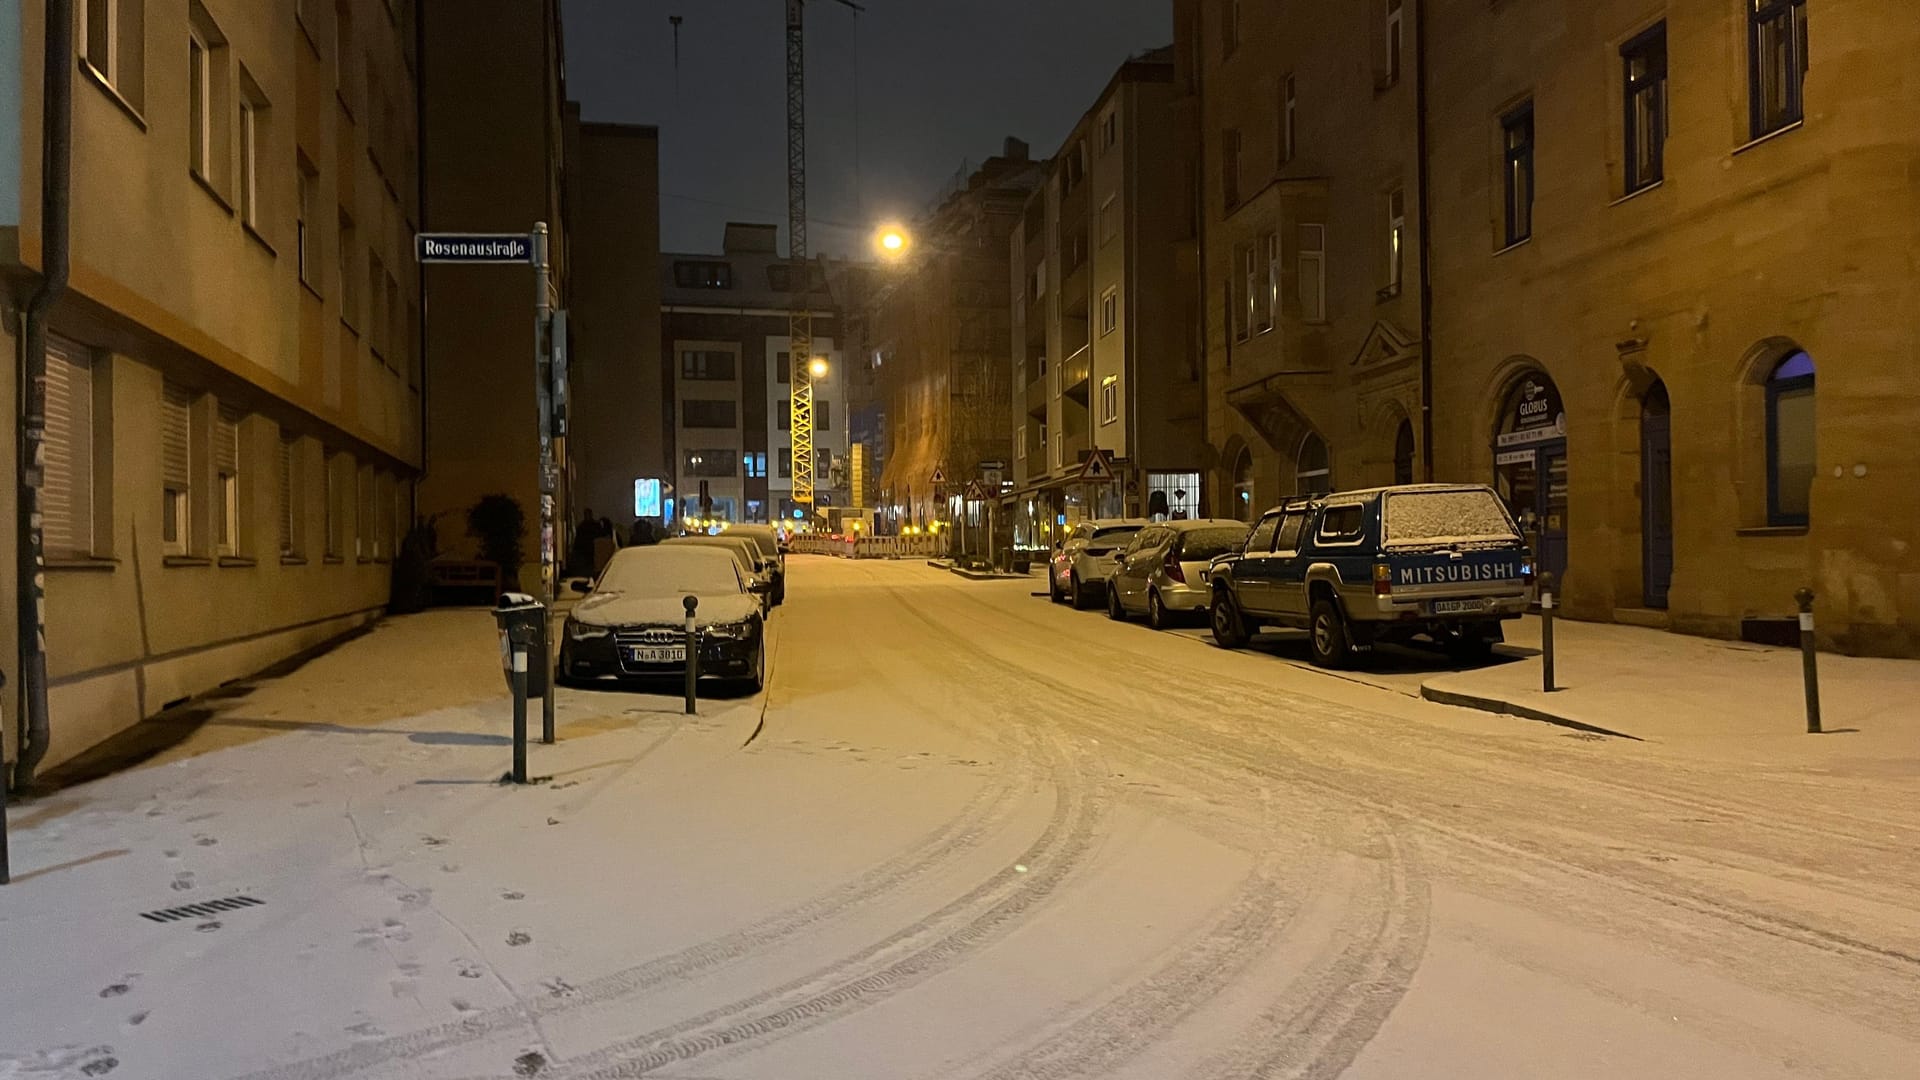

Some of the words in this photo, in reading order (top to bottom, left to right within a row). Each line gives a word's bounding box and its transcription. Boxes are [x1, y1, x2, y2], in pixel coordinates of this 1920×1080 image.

[426, 240, 525, 258] Rosenaustraße
[1520, 399, 1548, 416] GLOBUS
[1401, 563, 1514, 584] MITSUBISHI
